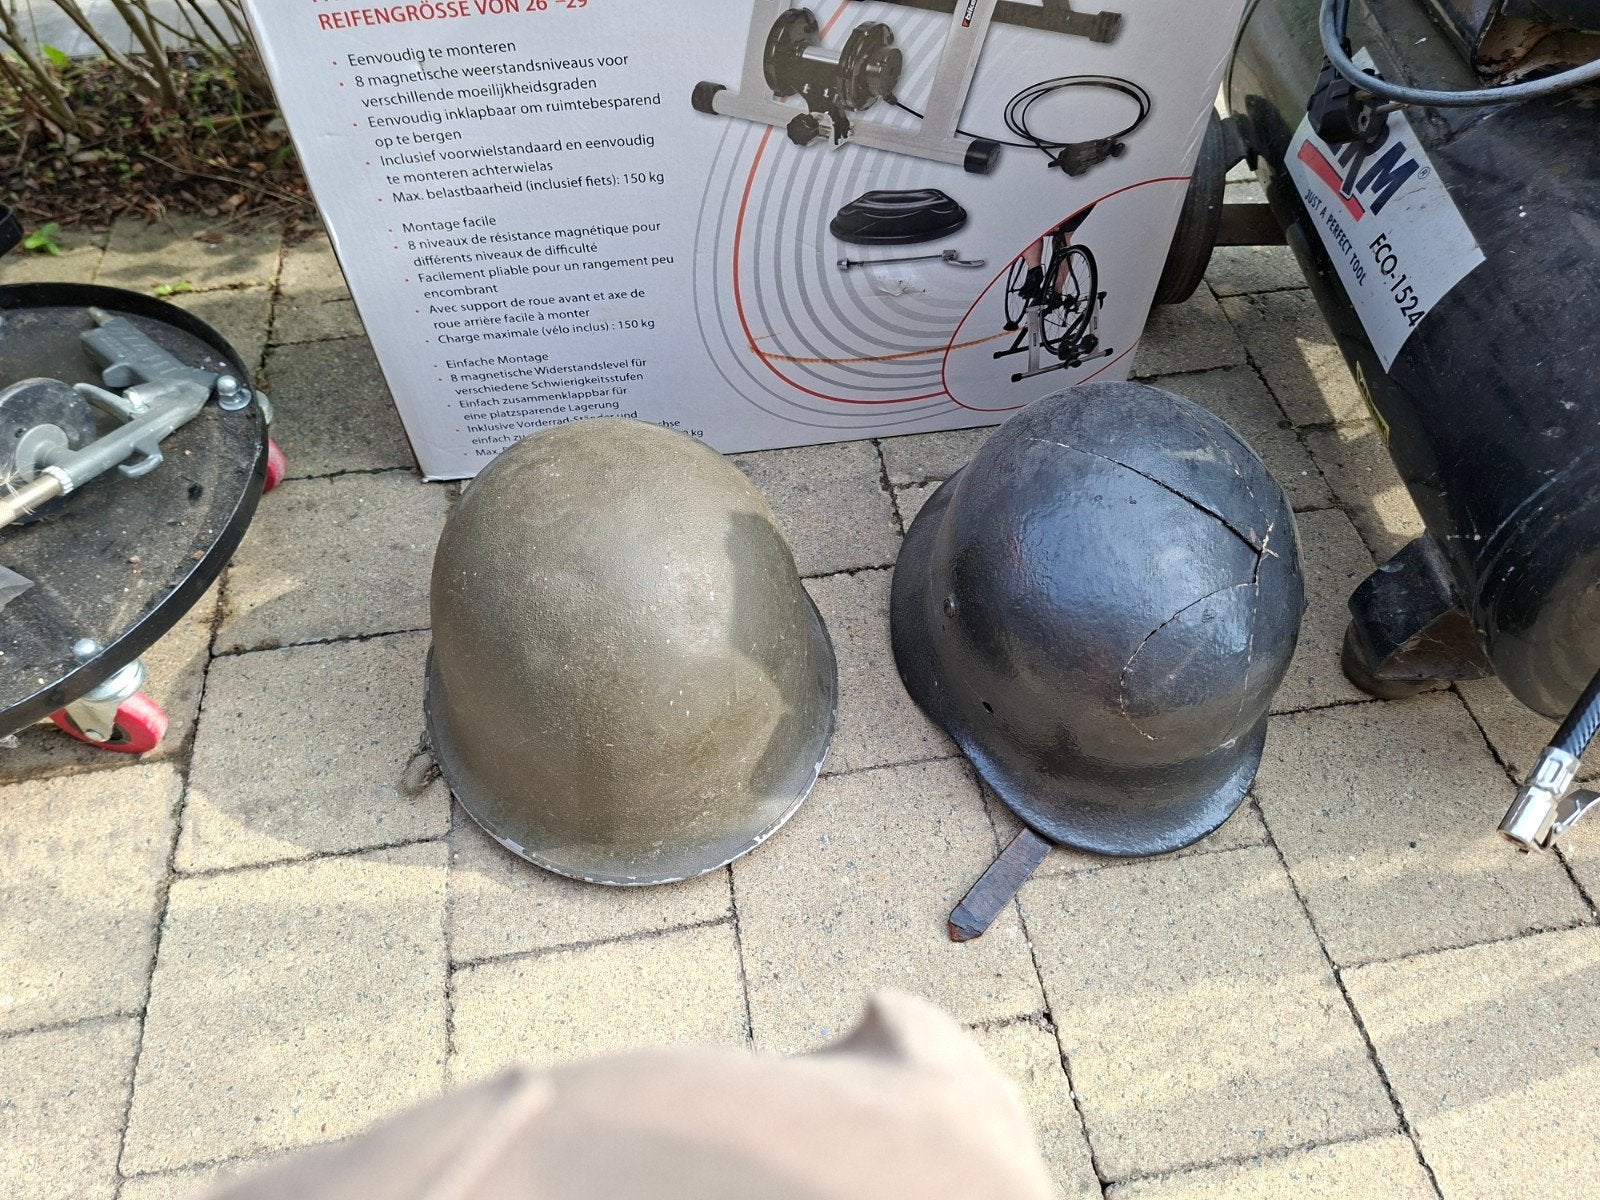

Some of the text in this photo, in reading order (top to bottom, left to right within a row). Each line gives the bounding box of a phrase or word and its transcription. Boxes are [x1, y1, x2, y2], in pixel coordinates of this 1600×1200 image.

[318, 1, 471, 30] REIFENGRÖSSE
[477, 0, 520, 16] VON
[347, 42, 516, 66] Eenvoudig te monteren
[355, 56, 628, 87] 8 magnetische weerstandsniveaus voor
[361, 77, 597, 108] verschillende moeilijkheidsgraden
[368, 92, 661, 128] Eenvoudig inklapbaar om ruimtebesparend
[375, 131, 462, 149] op te bergen
[380, 134, 654, 166] Inclusief voorwielstandaard en eenvoudig
[386, 160, 553, 185] te monteren achterwielas
[392, 171, 664, 203] Max. belastbaarheid (inclusief fiets): 150 kg
[402, 215, 496, 233] Montage facile
[408, 223, 660, 250] 8 niveaux de résistance magnétique pour
[1305, 189, 1366, 287] JUST A PERFECT TOOL
[413, 242, 598, 267] différents niveaux de difficulté
[418, 256, 674, 283] Facilement pliable pour un rangement peu
[1369, 232, 1425, 327] ECO-1524
[424, 285, 498, 299] encombrant
[430, 288, 645, 314] Avec support de roue avant et axe de
[434, 309, 590, 329] roue arrière facile à monter
[438, 334, 480, 344] Charge
[483, 327, 539, 340] maximale
[541, 325, 570, 336] (vélo
[572, 321, 609, 333] inclus)
[618, 320, 639, 329] 150
[641, 319, 655, 329] kg
[446, 354, 549, 369] Einfache Montage
[450, 358, 646, 382] 8 magnetische Widerstandslevel für
[455, 372, 643, 395] verschiedene Schwierigkeitsstufen
[459, 386, 627, 408] Einfach zusammenklappbar für
[489, 405, 566, 420] platzsparende
[568, 402, 619, 413] Lagerung
[467, 422, 515, 433] Inklusive
[472, 435, 510, 444] einfach
[691, 429, 704, 437] kg
